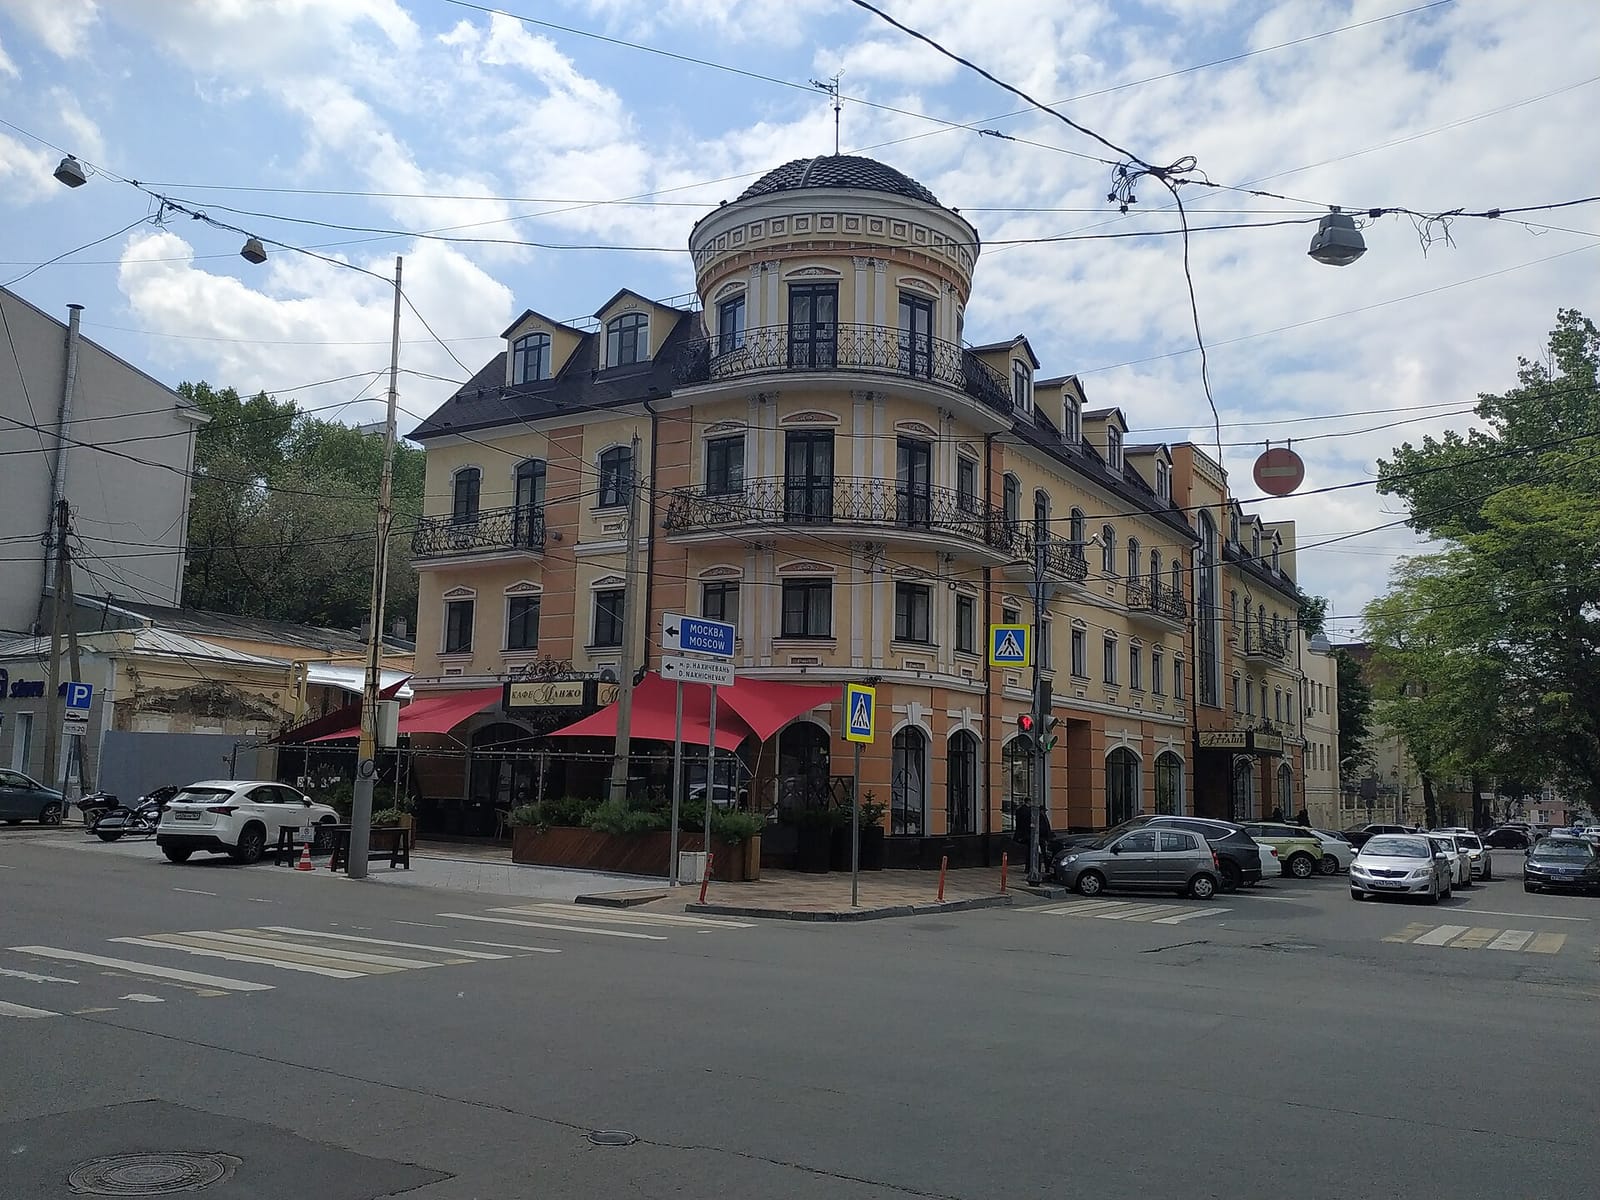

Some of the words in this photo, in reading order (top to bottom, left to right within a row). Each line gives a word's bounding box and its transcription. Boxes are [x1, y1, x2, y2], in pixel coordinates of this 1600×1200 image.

[689, 623, 724, 638] МОСКВА
[689, 636, 725, 650] MOSCOW
[72, 685, 89, 705] P
[511, 690, 533, 699] КАФЕ
